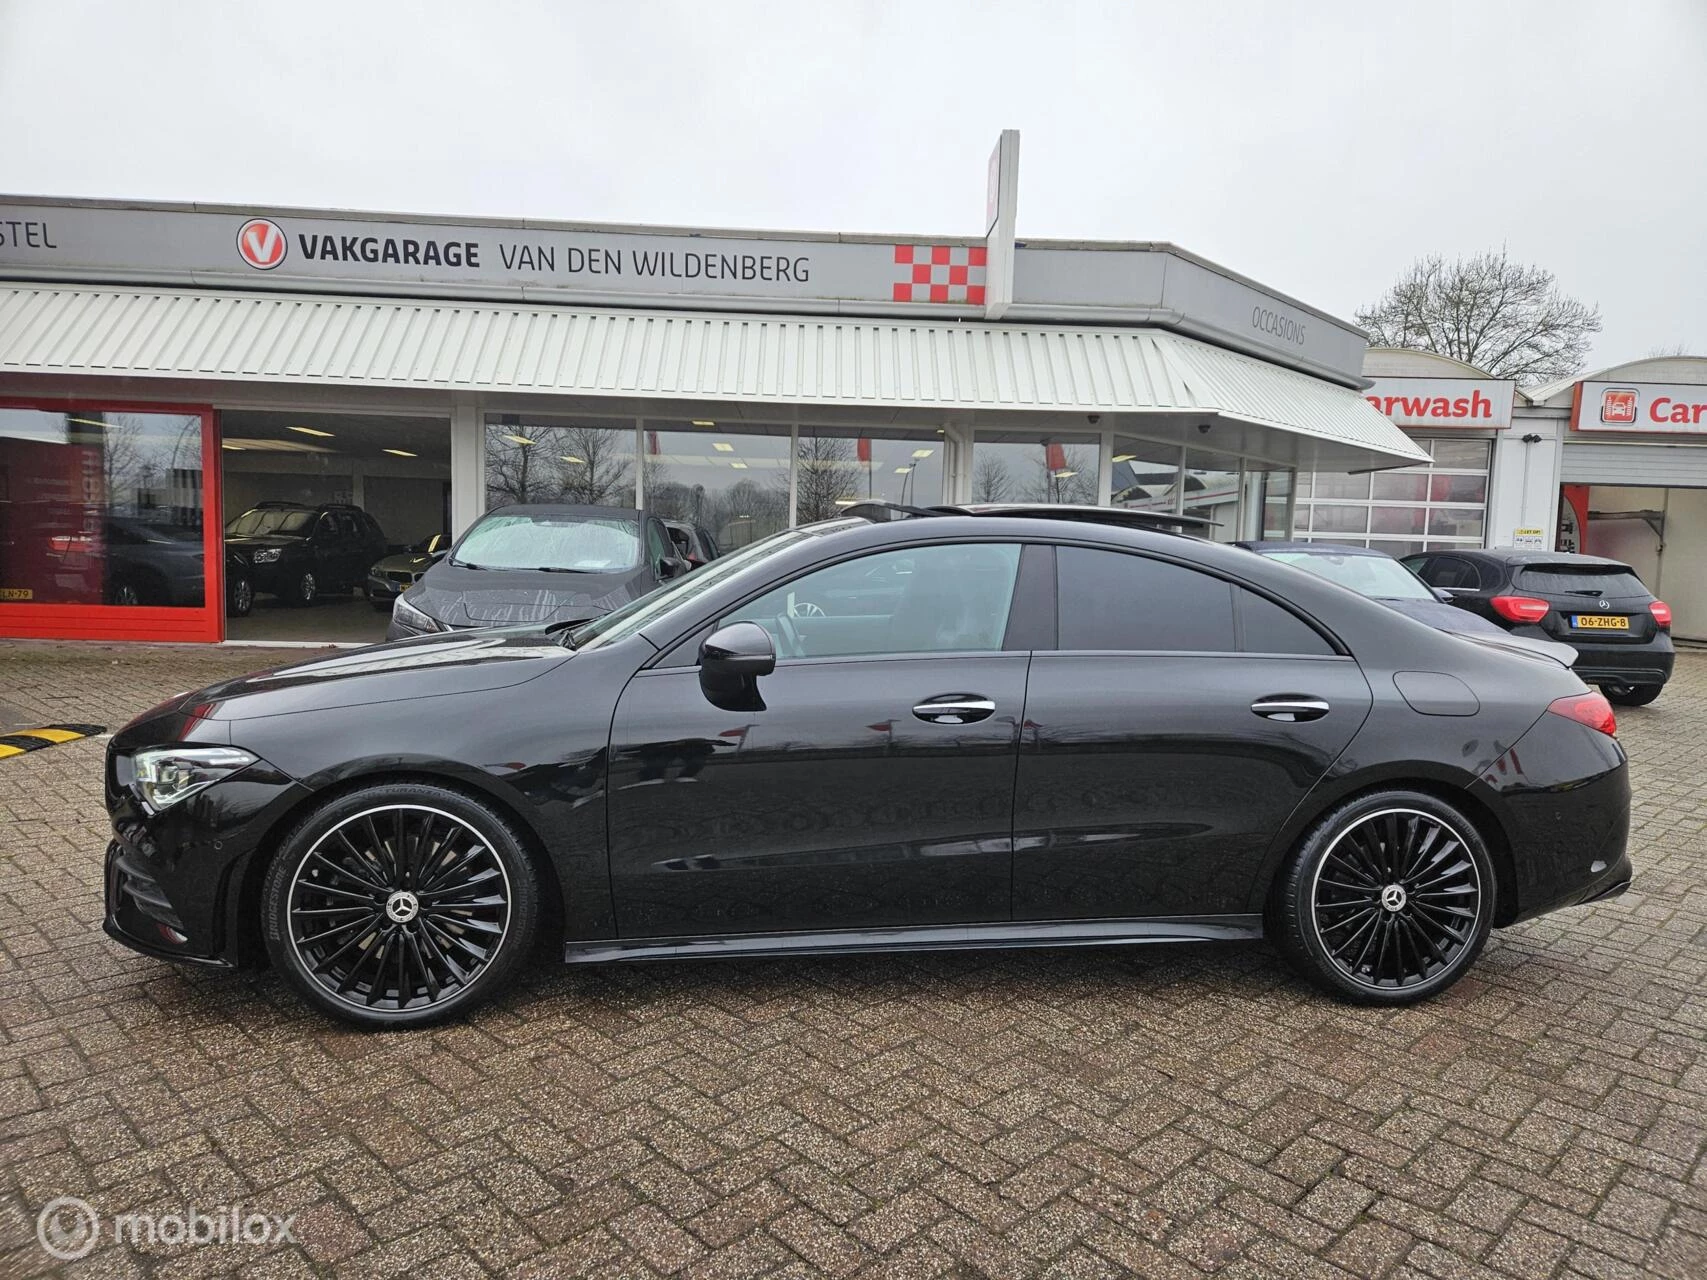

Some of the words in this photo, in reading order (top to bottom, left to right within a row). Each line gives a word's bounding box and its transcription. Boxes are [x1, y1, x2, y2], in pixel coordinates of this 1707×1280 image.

[298, 233, 481, 268] VAKGARAGE
[499, 243, 555, 272] VAN
[567, 247, 622, 275] DEN
[632, 249, 810, 283] WILDENBERG
[1252, 306, 1306, 346] OCCASIONS
[1649, 397, 1707, 424] Car
[1580, 616, 1626, 628] 06-ZHG-8
